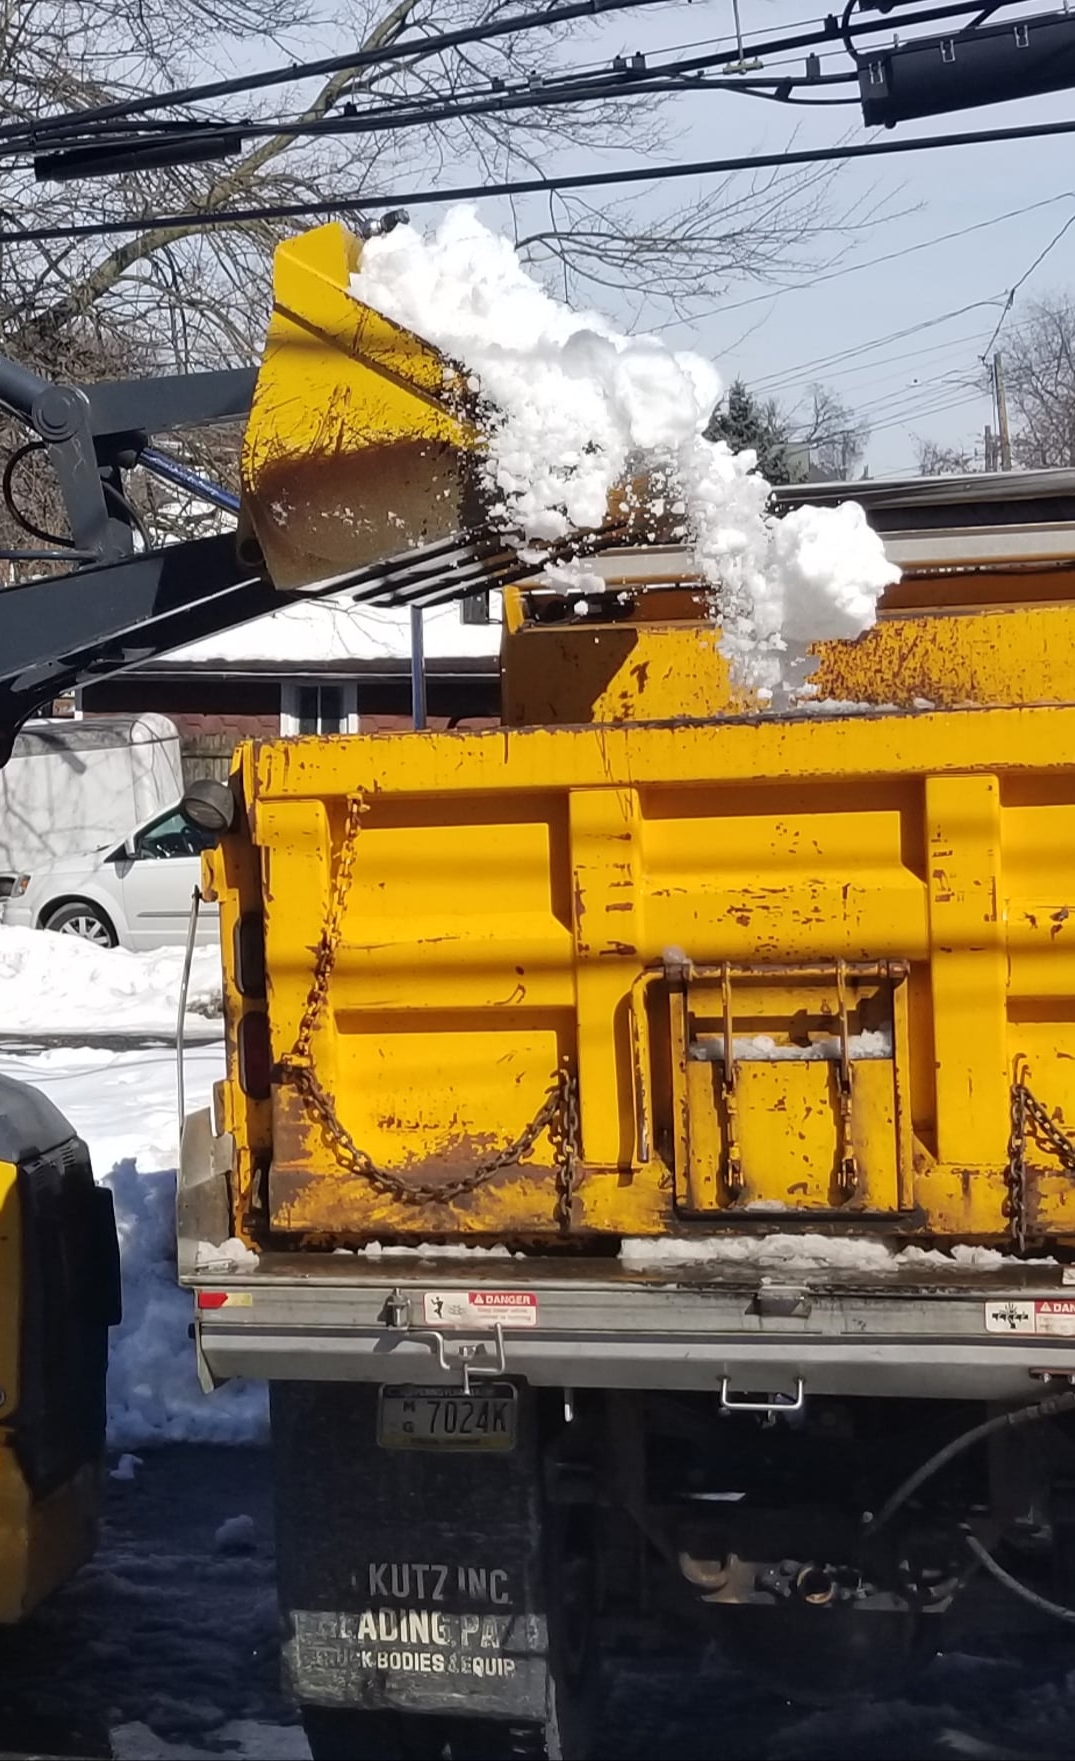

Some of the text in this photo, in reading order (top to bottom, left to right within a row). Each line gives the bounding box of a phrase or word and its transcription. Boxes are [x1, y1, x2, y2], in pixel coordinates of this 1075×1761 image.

[485, 1294, 531, 1305] DANGER
[427, 1400, 507, 1434] 7024K
[368, 1562, 449, 1601] KUTZ
[377, 1652, 445, 1673] BODIES
